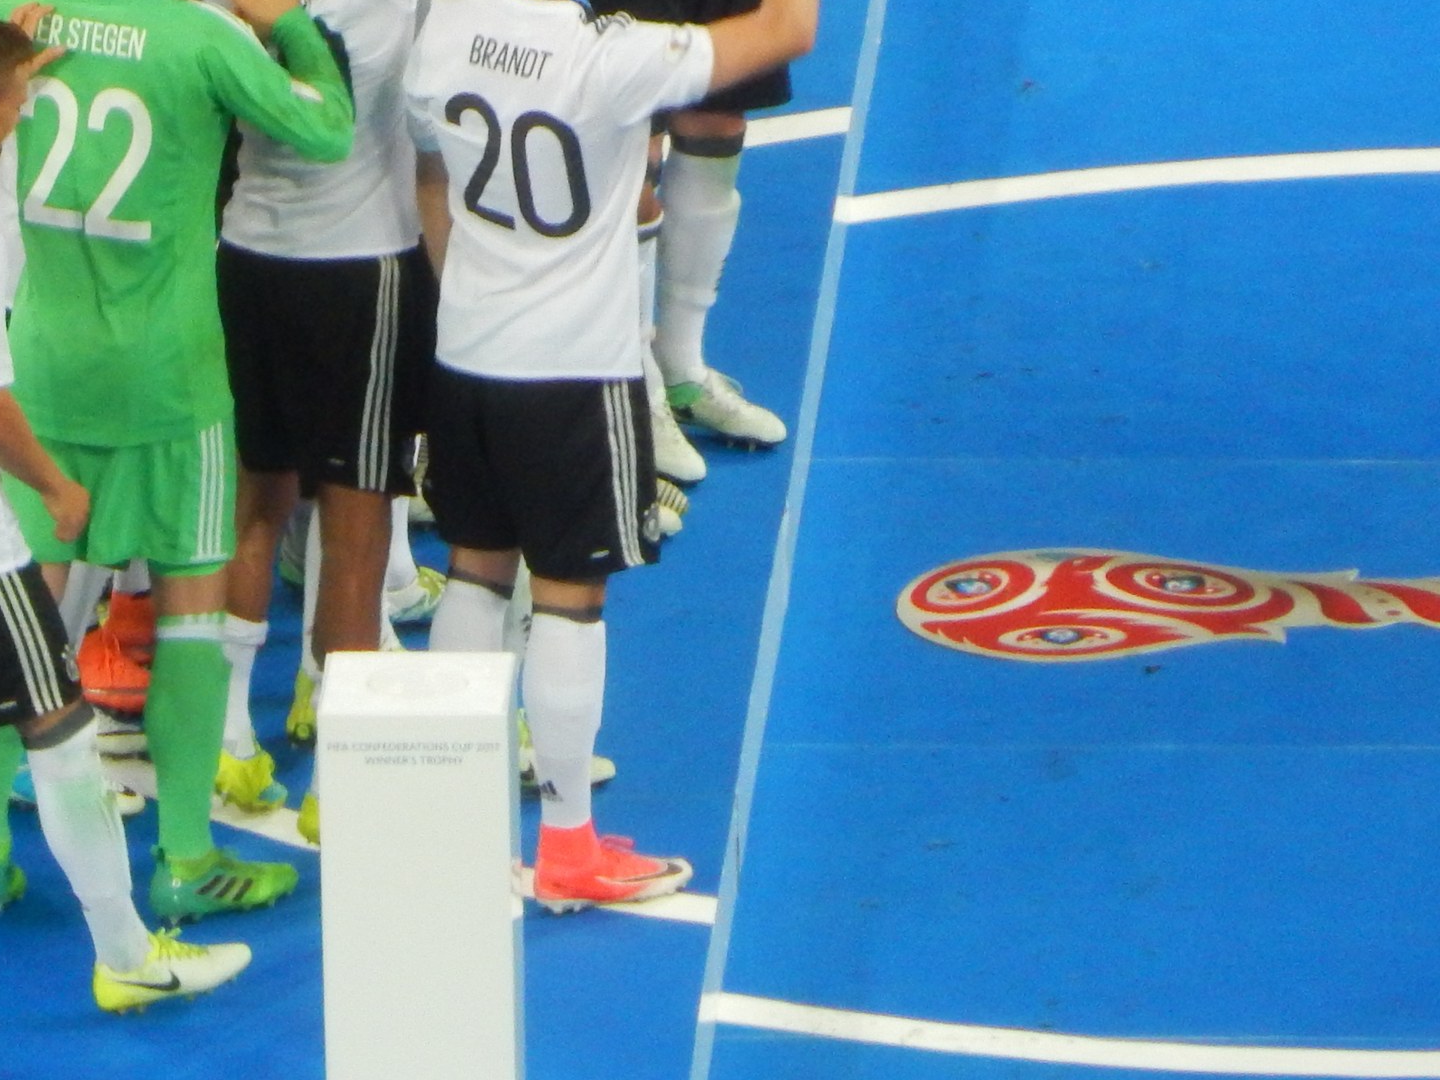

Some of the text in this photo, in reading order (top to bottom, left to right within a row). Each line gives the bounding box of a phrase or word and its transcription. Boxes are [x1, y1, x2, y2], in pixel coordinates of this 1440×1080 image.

[35, 13, 147, 61] ER STEGEN
[469, 34, 554, 80] BRANDT
[20, 76, 153, 241] 22
[444, 91, 591, 238] 20
[451, 742, 474, 752] CUP
